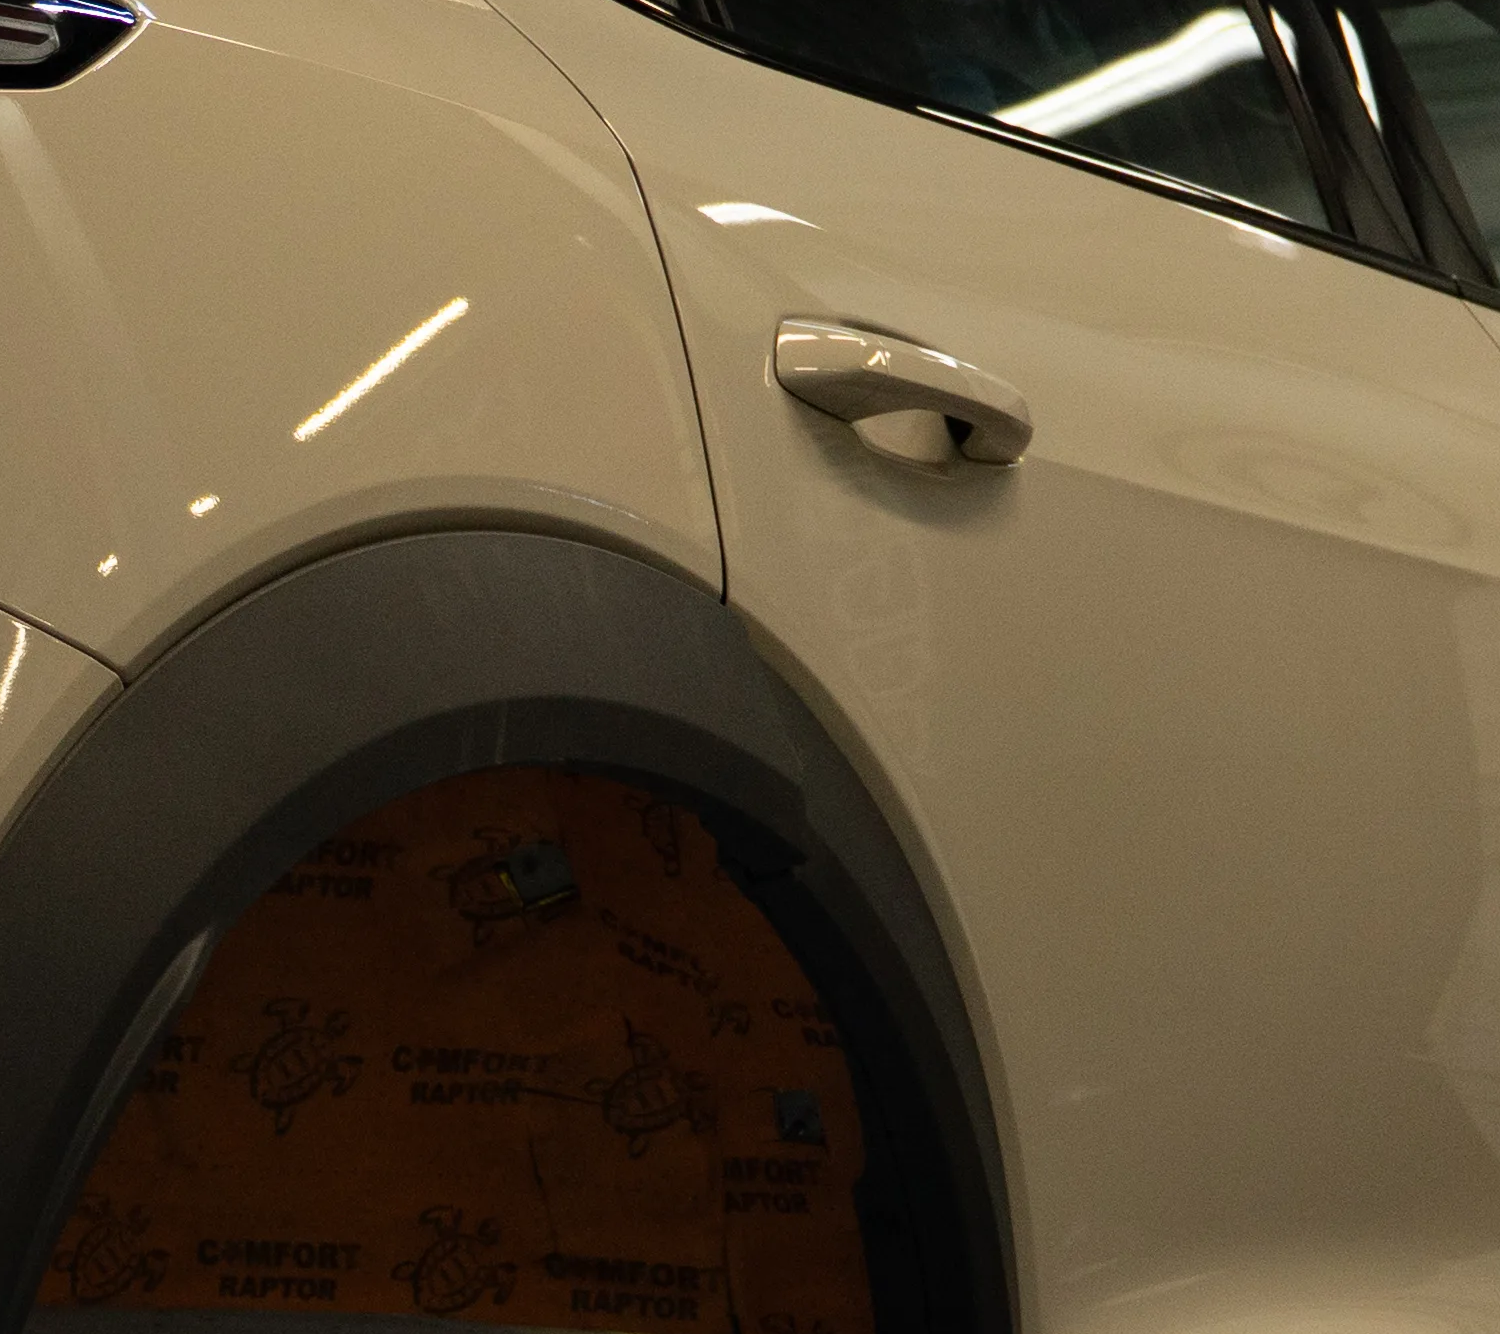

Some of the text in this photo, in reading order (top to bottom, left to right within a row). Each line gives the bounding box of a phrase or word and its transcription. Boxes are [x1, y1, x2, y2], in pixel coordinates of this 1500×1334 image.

[268, 871, 374, 900] APTOR
[410, 1078, 522, 1105] RAPTOR
[722, 1156, 821, 1186] MFORT
[723, 1191, 810, 1216] APTOR
[197, 1238, 361, 1270] COMFORT
[218, 1275, 338, 1301] RAPTOR
[571, 1289, 699, 1321] RAPTOR
